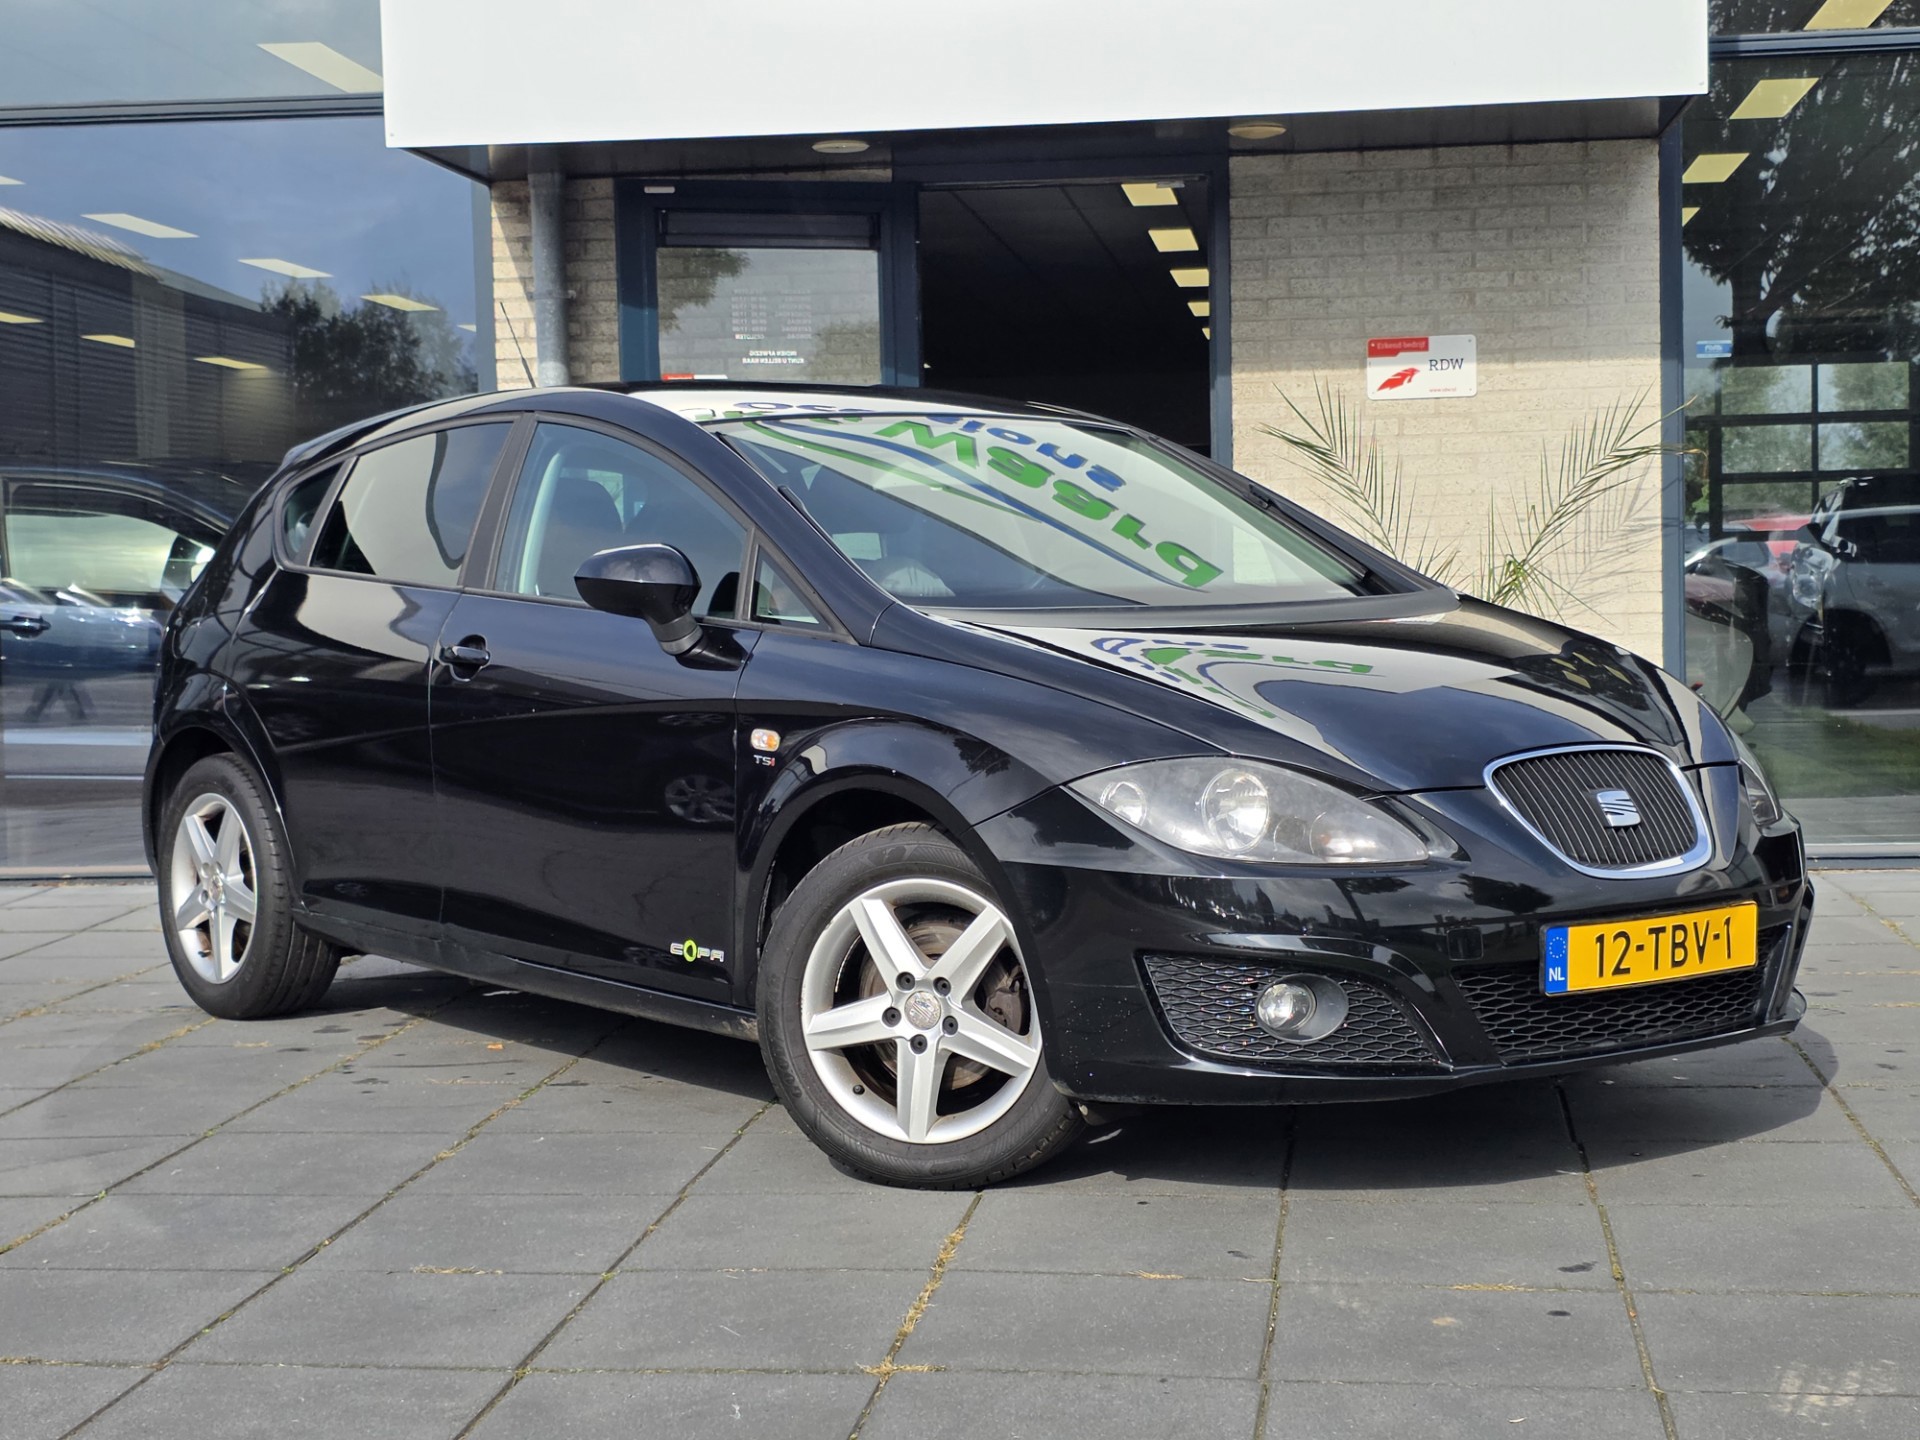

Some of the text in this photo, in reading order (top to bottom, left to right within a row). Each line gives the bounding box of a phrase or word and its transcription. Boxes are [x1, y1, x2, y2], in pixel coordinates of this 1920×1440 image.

[1428, 358, 1464, 371] RDW
[1595, 916, 1731, 978] 12-TBV-1
[1548, 967, 1565, 981] NL
